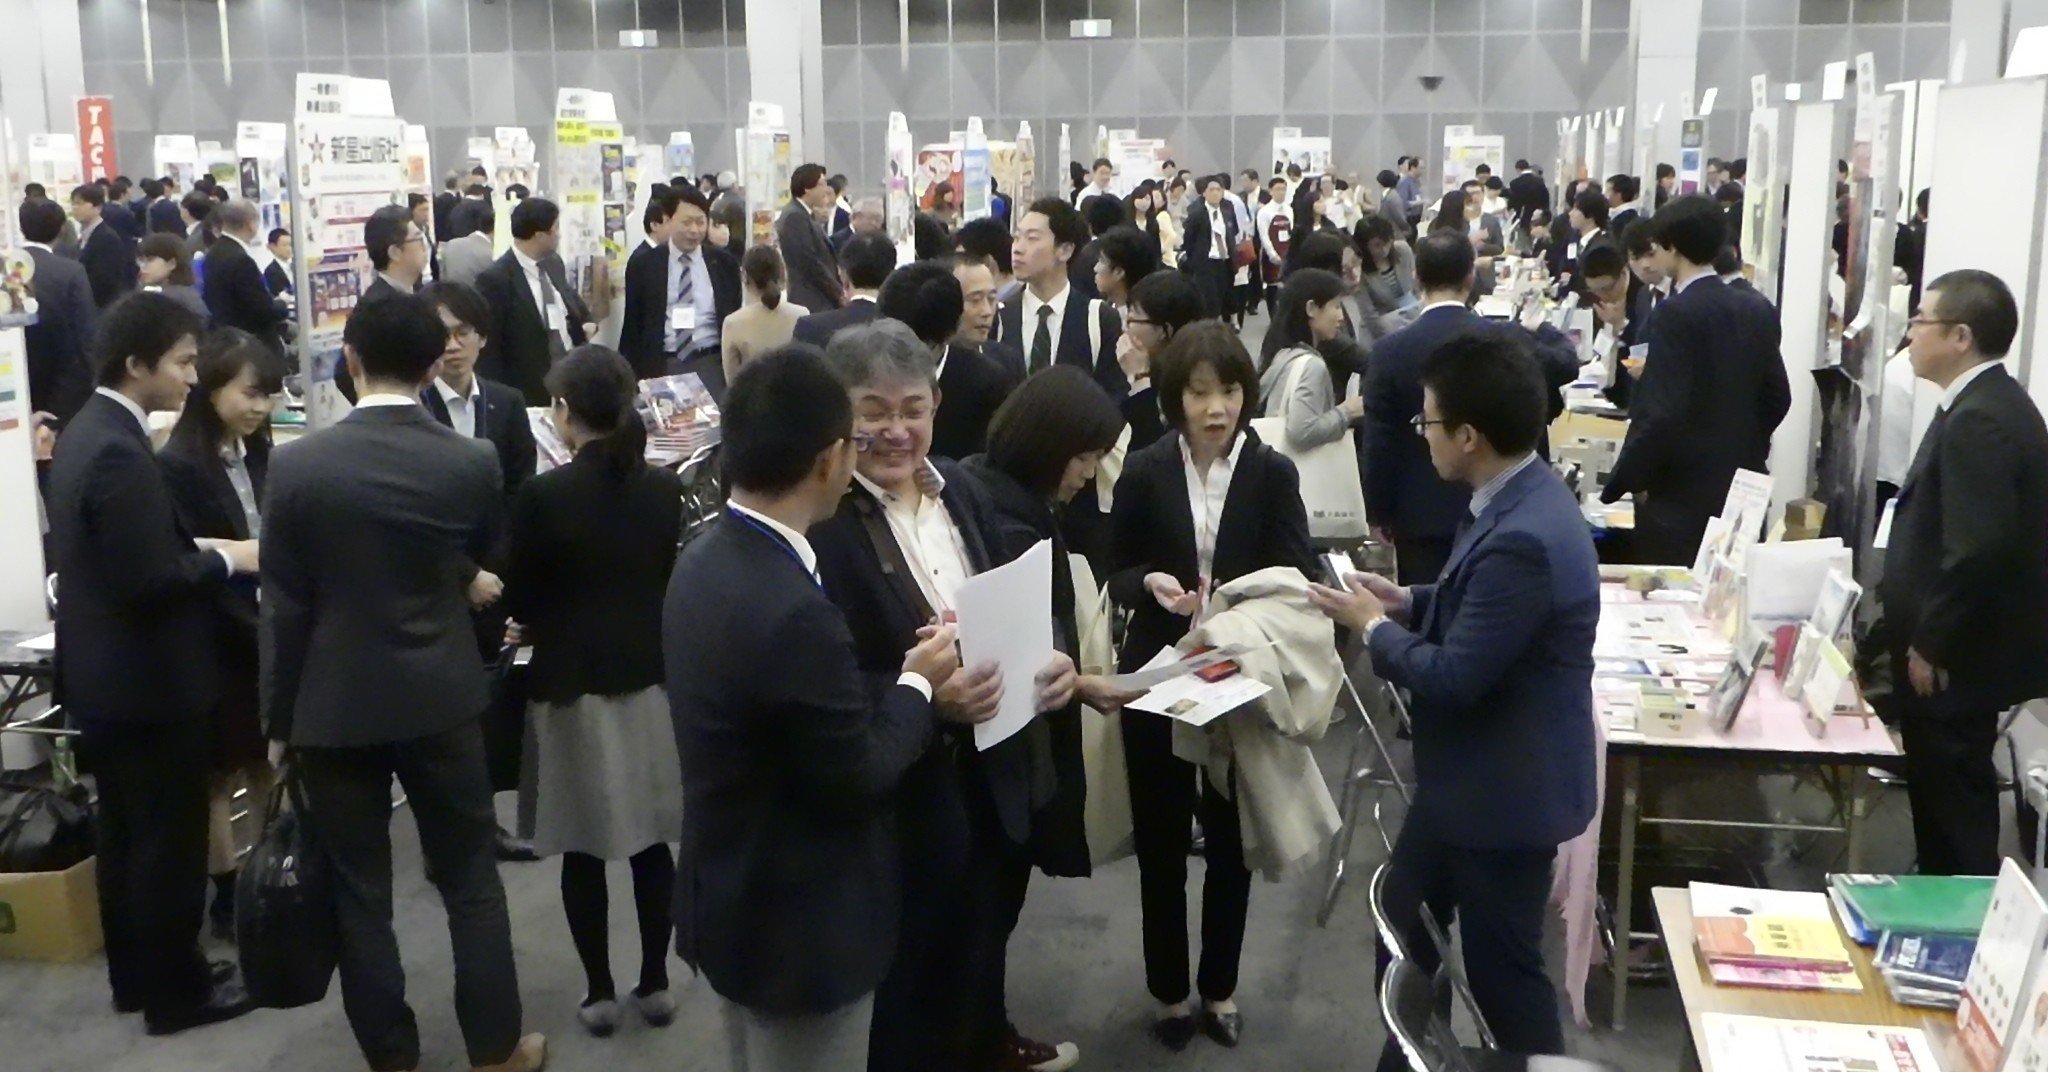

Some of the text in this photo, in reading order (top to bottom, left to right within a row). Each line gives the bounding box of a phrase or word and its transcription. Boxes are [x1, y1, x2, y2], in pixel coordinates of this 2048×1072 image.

[331, 136, 400, 164] 新星出版社
